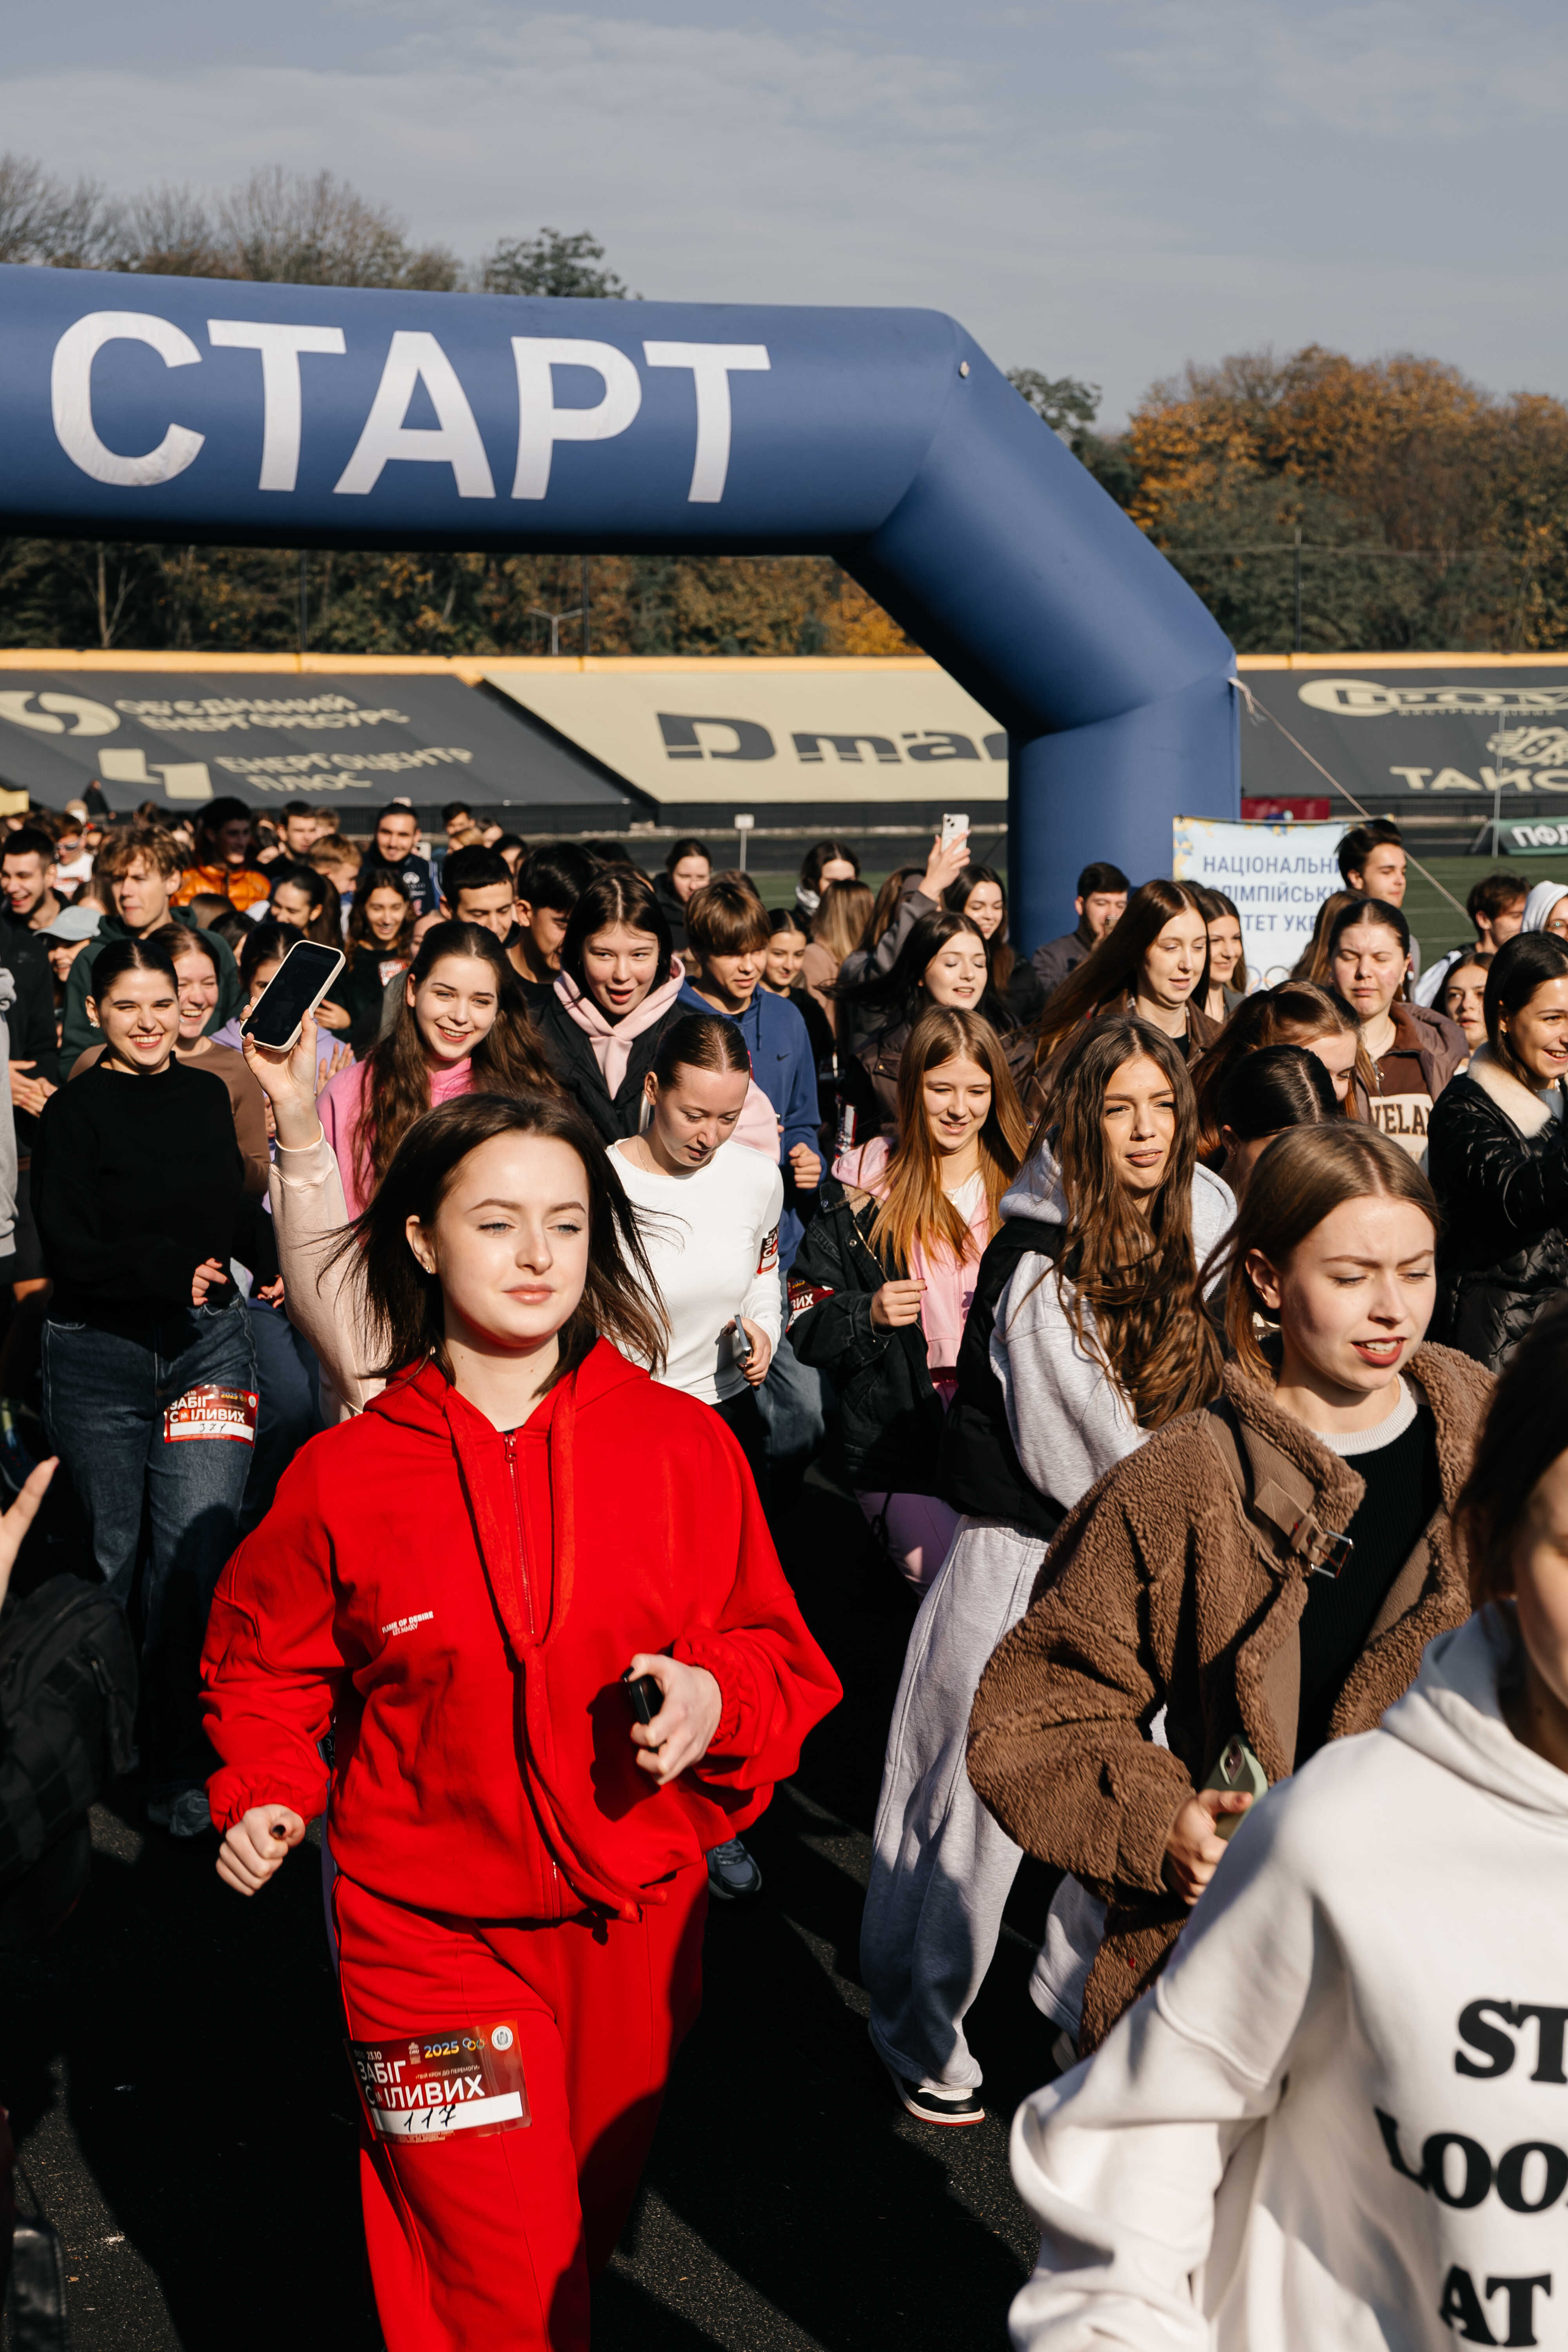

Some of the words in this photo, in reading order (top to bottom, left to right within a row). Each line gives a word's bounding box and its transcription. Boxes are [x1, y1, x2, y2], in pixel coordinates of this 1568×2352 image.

[51, 310, 771, 503] СТАРТ
[246, 771, 373, 792] ПЛЮС
[423, 2041, 459, 2059] 2025
[357, 2060, 406, 2084] ЗАБІГ
[404, 2104, 457, 2132] 117
[1374, 2105, 1568, 2214] LOO
[1440, 2264, 1552, 2347] AT
